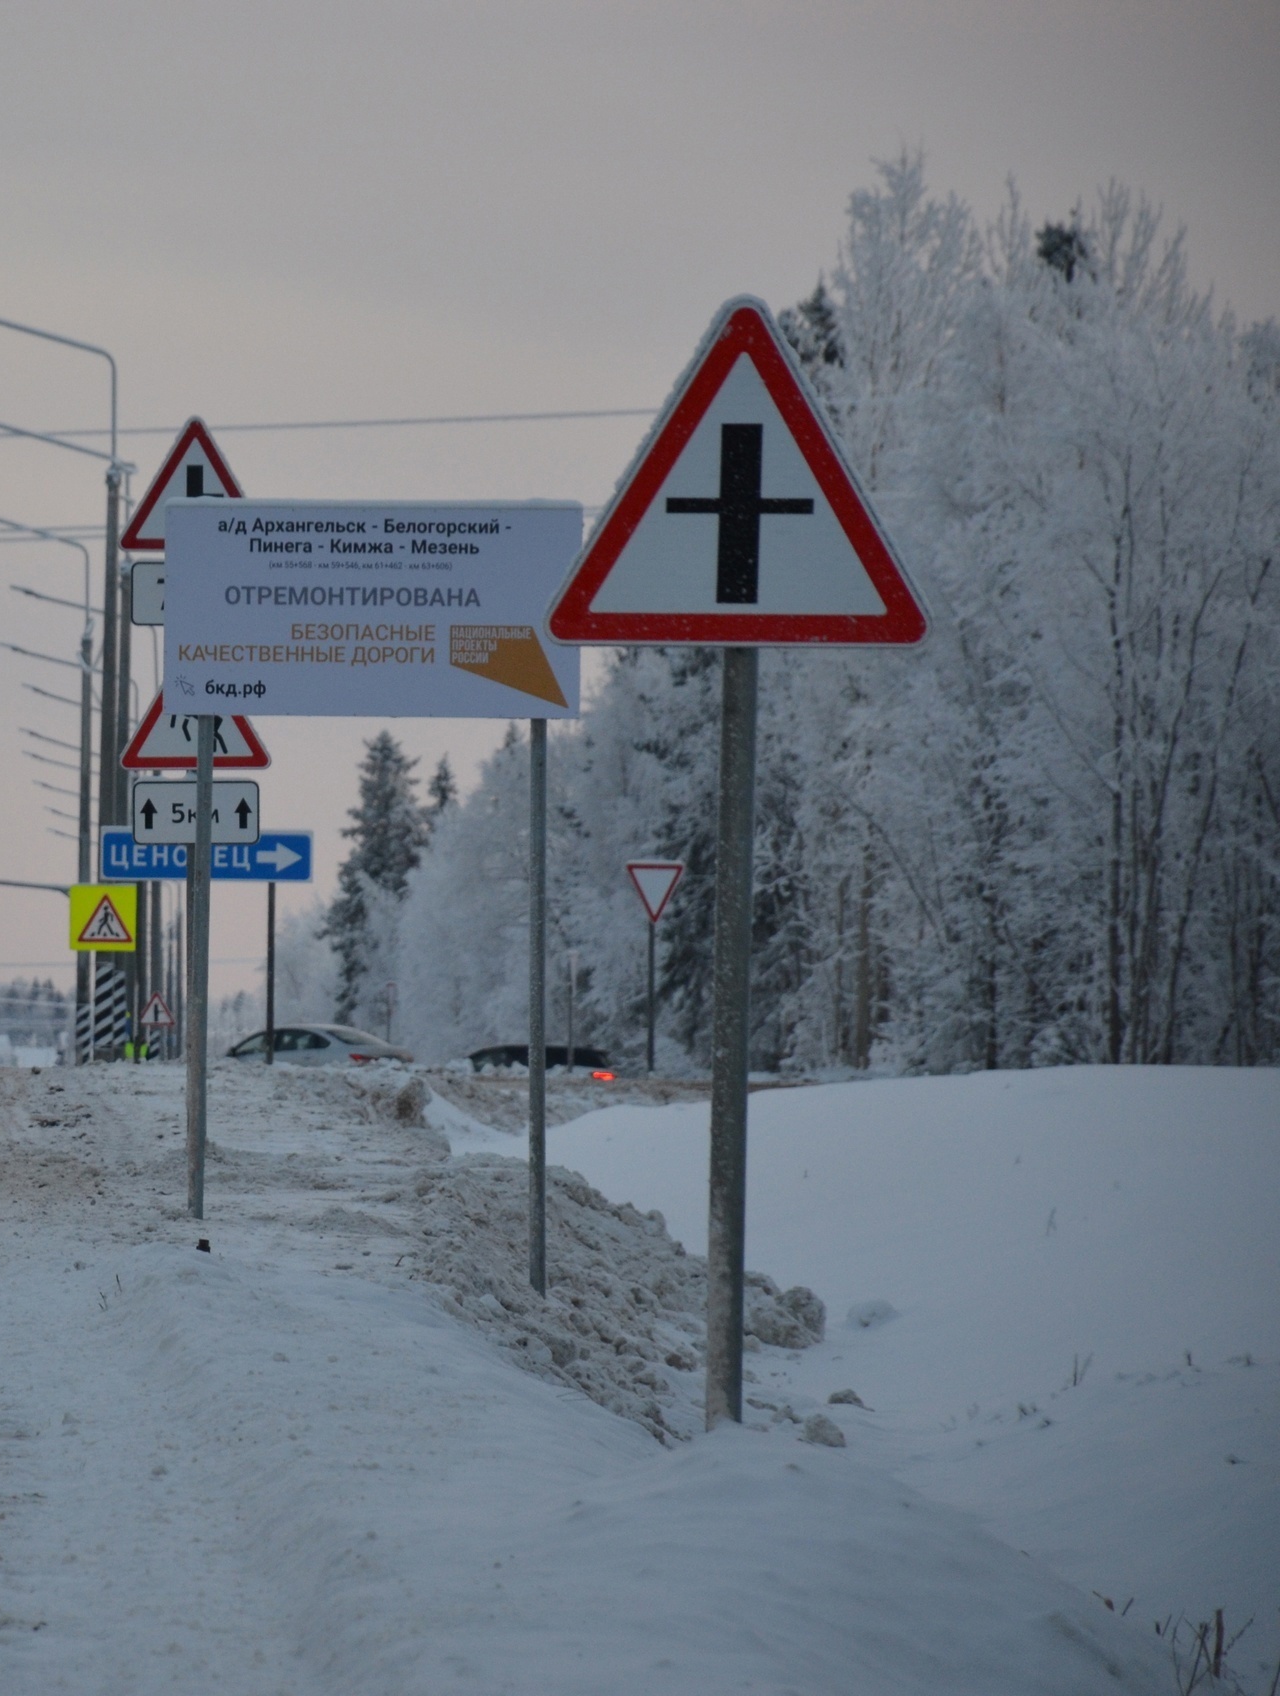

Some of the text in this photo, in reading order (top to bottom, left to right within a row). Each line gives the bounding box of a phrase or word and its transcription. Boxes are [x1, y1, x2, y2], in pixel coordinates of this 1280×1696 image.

[218, 517, 247, 535] а/д
[252, 518, 367, 536] Архангельск
[384, 518, 500, 537] Белогорский
[249, 538, 313, 553] Пинега
[330, 539, 394, 554] Кимжа
[411, 540, 480, 554] Мезень
[224, 586, 481, 607] ОТРЕМОНТИРОВАНА
[291, 623, 436, 641] БЕЗОПАСНЫЕ
[452, 627, 532, 639] НАЦИОНАЛЬНЫЕ
[452, 639, 497, 651] ПРОЕКТЫ
[178, 645, 435, 666] КАЧЕСТВЕННЫЕ ДОРОГИ
[452, 652, 489, 664] РОССИИ
[205, 679, 267, 698] бкд.рф
[110, 844, 251, 871] ЦЕНОЕЦ
